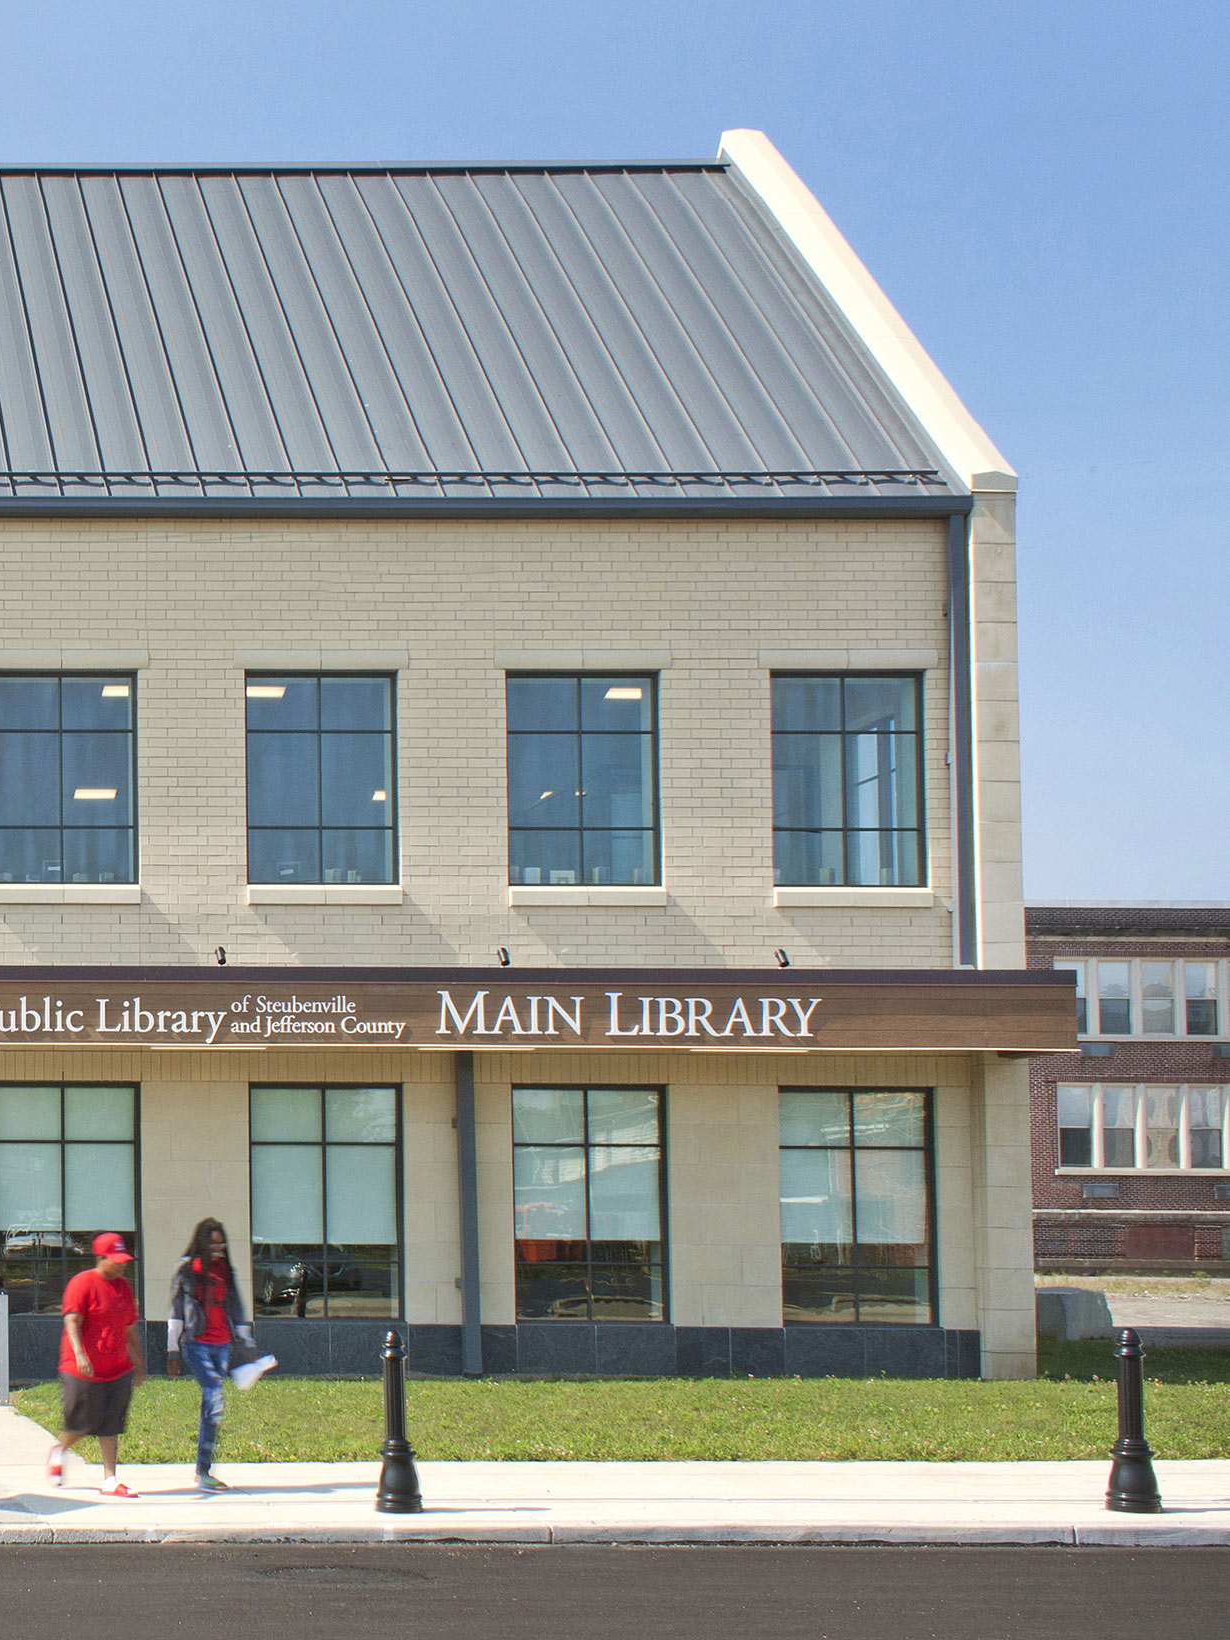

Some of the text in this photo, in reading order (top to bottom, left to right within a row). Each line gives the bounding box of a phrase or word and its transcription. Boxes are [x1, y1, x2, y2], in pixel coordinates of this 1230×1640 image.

[95, 996, 228, 1044] Library
[230, 994, 356, 1014] of Steubenville
[435, 990, 823, 1037] MAIN LIBRARY
[230, 1015, 406, 1039] and Jefferson County
